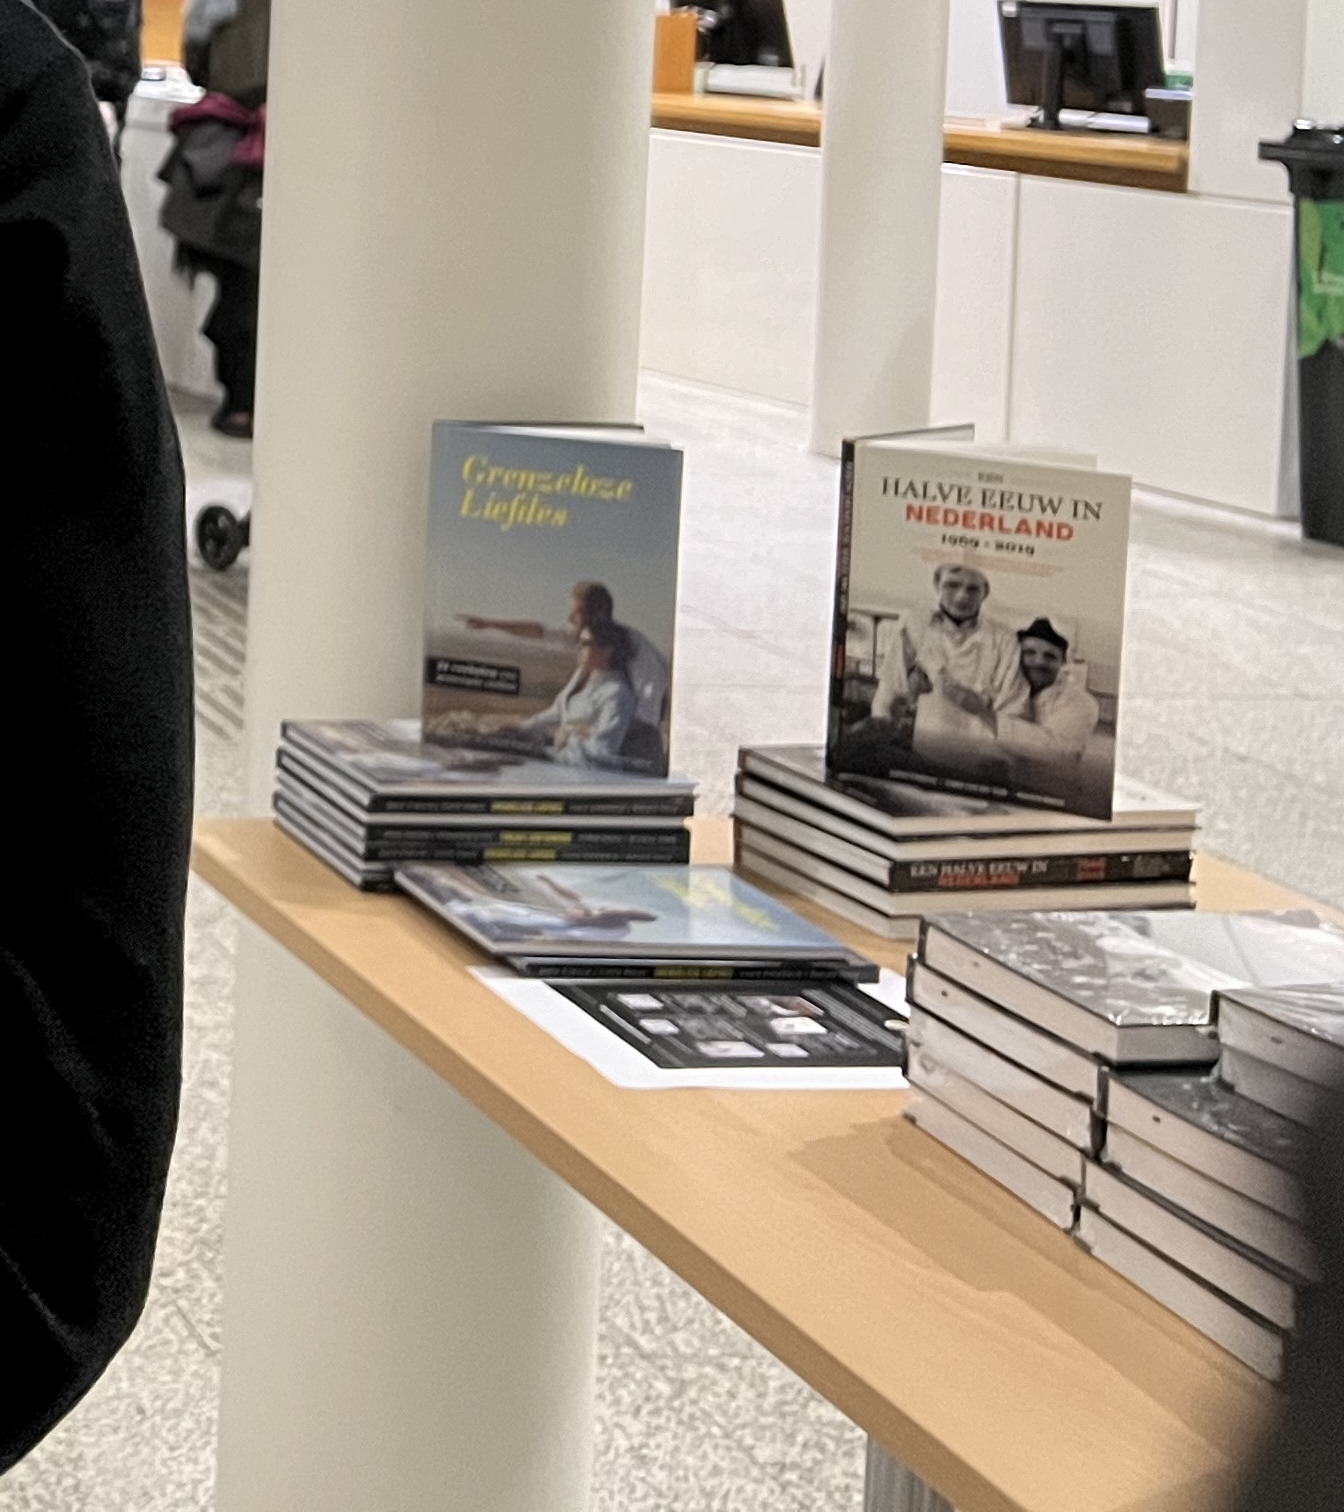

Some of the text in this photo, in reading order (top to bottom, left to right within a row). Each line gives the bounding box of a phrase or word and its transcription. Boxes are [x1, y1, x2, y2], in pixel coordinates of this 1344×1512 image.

[462, 453, 633, 502] Grenzeloze
[882, 476, 1104, 521] HALVE EEUW IN
[460, 488, 568, 533] Liefdes
[905, 503, 1075, 542] NEDERLAND
